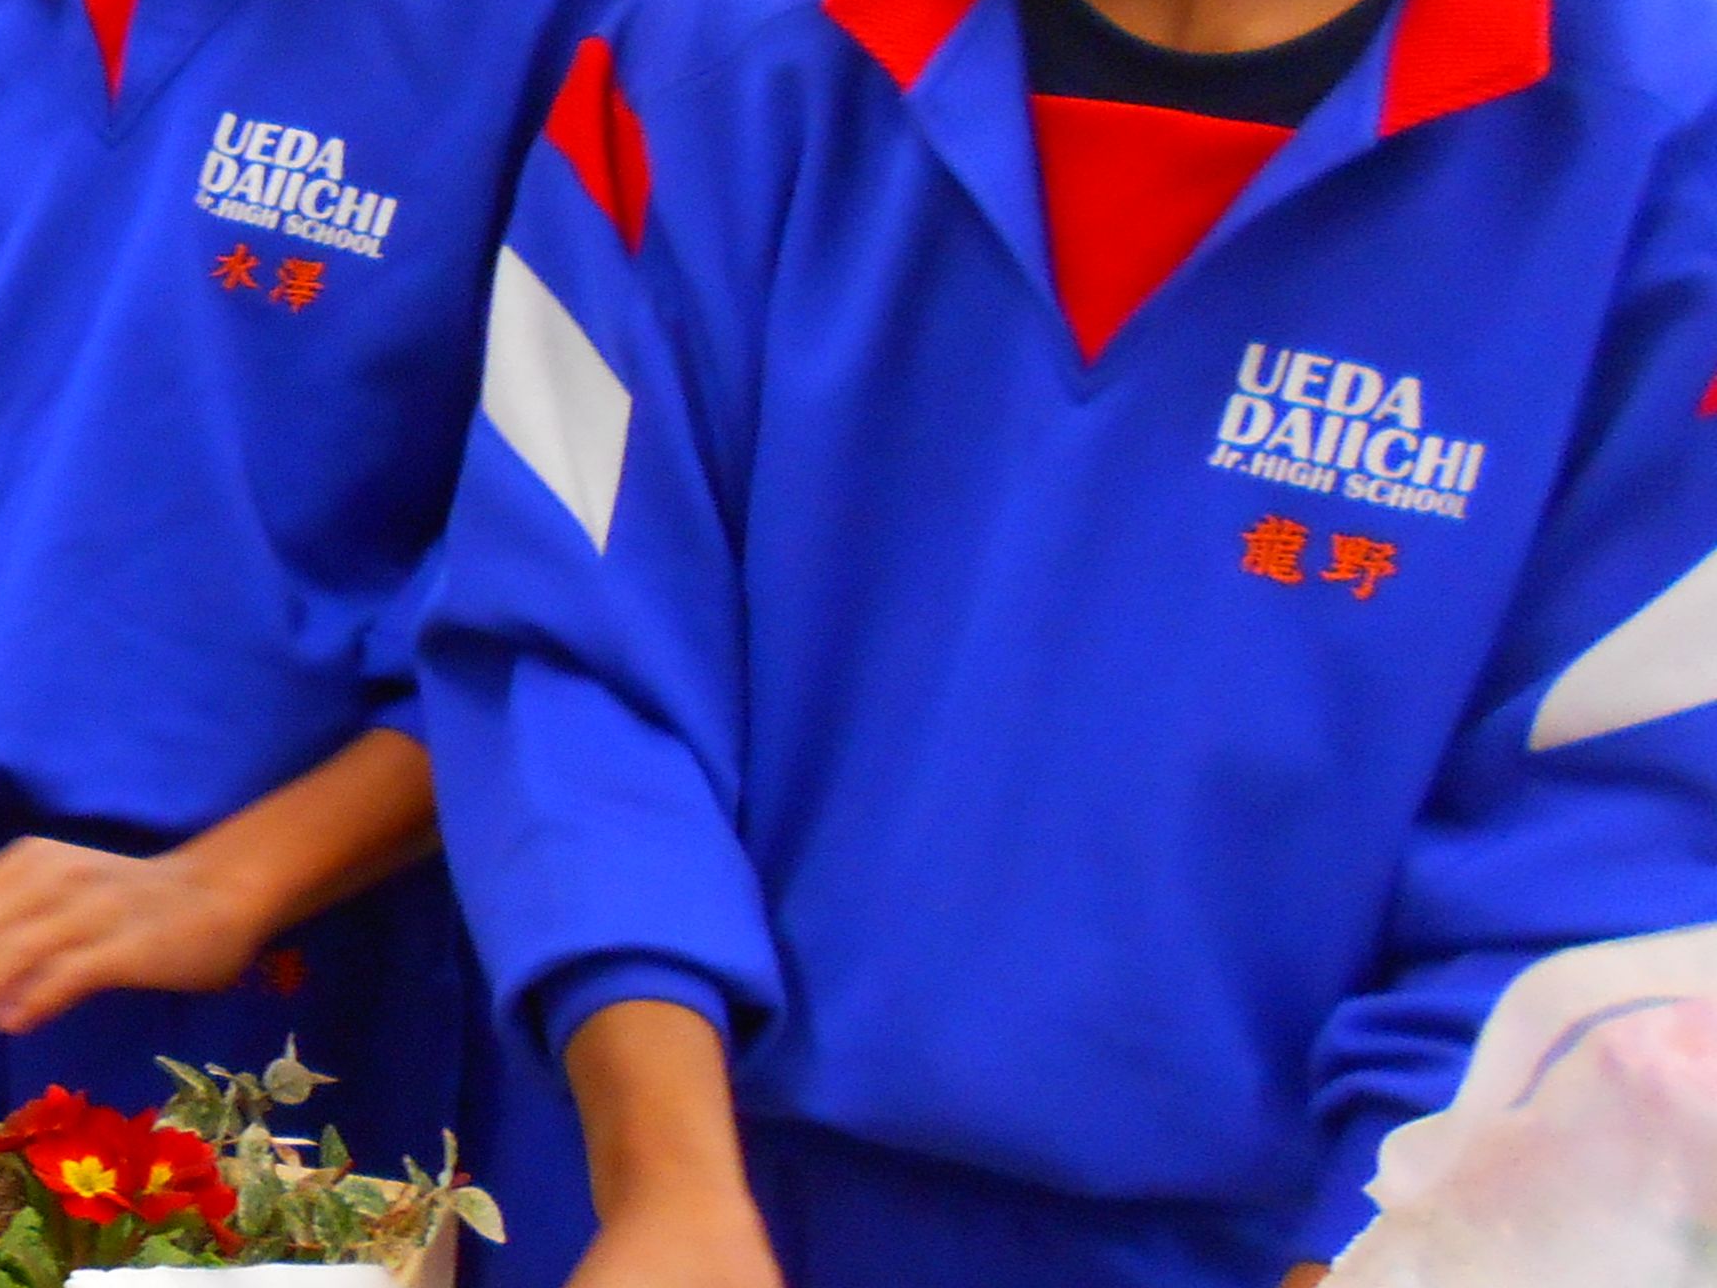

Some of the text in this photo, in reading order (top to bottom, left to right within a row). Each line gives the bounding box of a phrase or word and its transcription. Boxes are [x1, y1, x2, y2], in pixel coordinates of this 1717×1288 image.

[213, 112, 345, 180] UEDA
[199, 150, 398, 237] DAIICHI
[1237, 344, 1422, 429] UEDA
[1218, 394, 1486, 493] DAIICHI
[1343, 473, 1468, 520] SCHOOL
